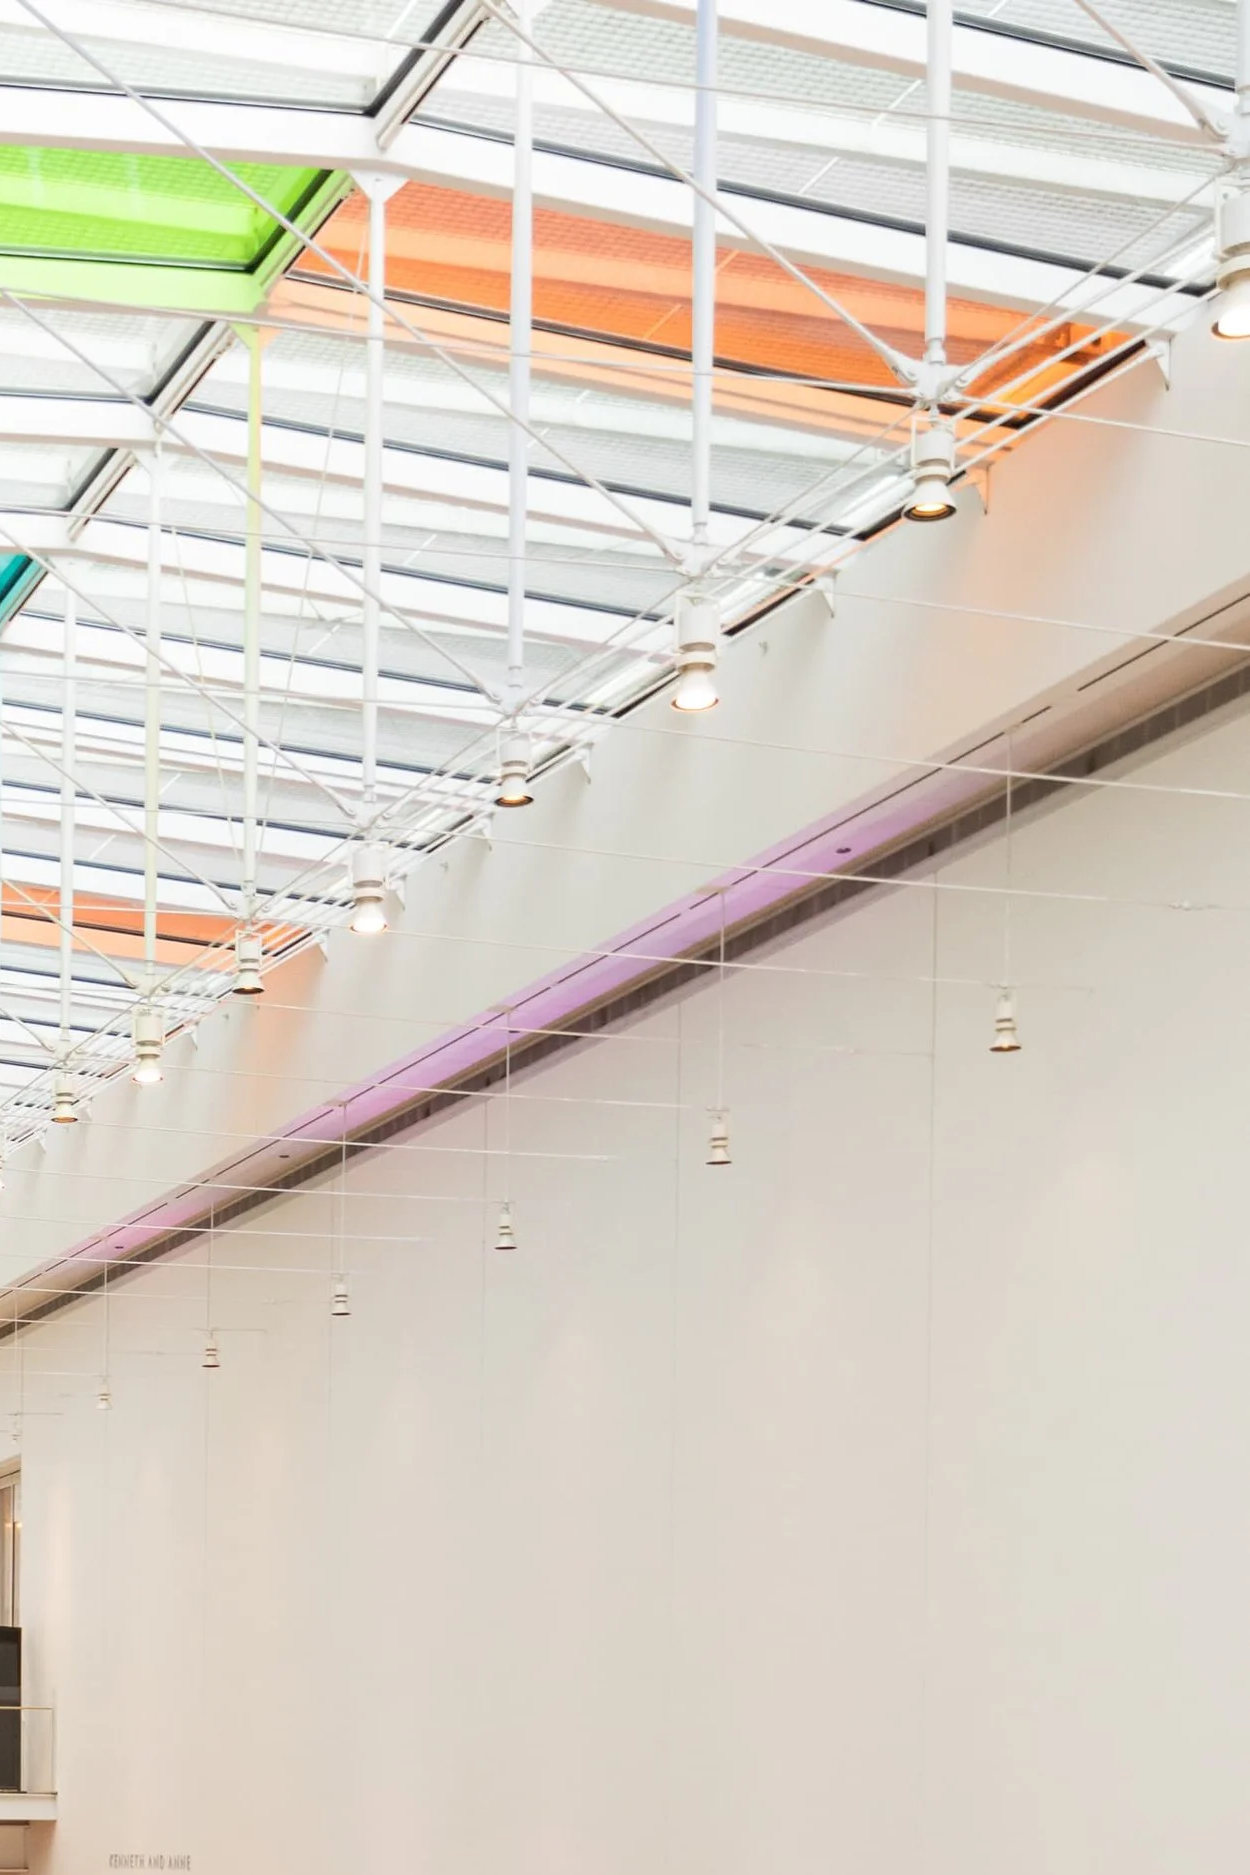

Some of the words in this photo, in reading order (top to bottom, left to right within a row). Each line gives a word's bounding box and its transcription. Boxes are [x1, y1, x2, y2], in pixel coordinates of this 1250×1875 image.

[108, 1853, 145, 1869] KENNETH
[147, 1854, 165, 1870] AND
[168, 1854, 191, 1871] ANNE
